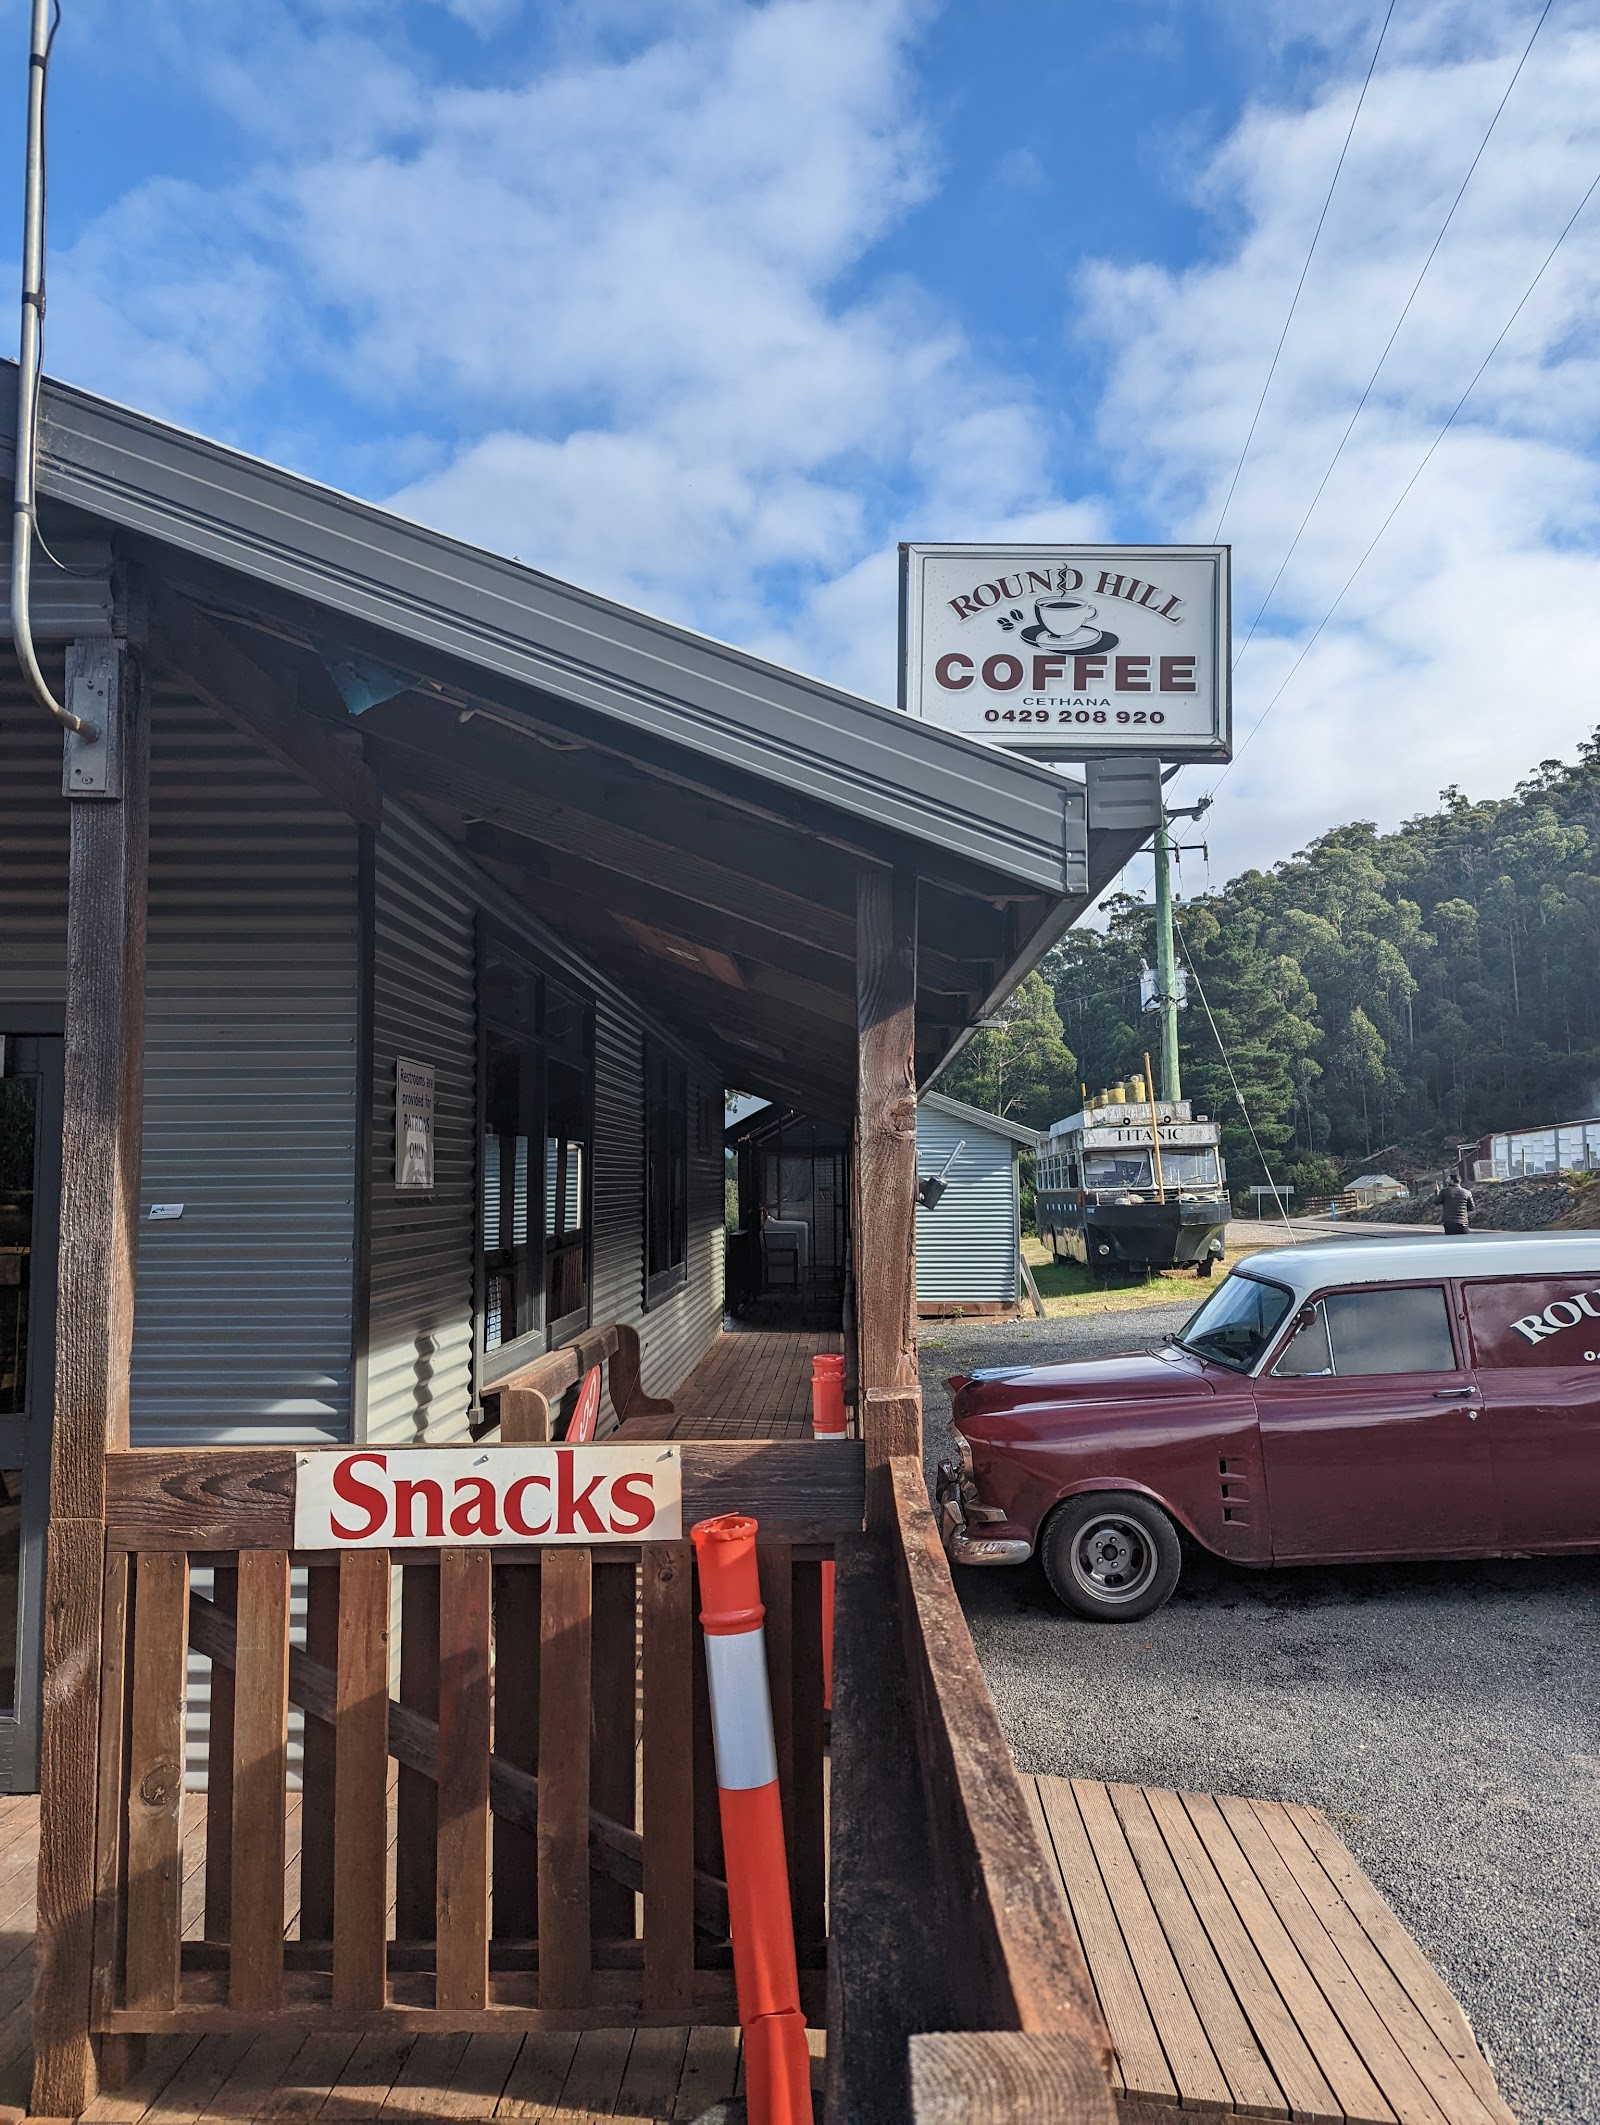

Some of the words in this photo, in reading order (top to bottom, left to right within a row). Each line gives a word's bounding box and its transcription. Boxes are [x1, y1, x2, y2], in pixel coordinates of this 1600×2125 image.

[947, 568, 1084, 621] ROUND
[1094, 571, 1183, 623] HILL
[935, 653, 1196, 692] COFFEE
[1023, 697, 1111, 707] CETHANA
[985, 709, 1049, 723] 0429
[1059, 710, 1107, 724] 208
[1116, 711, 1165, 725] 920
[400, 1068, 426, 1088] Restrooms
[426, 1077, 434, 1089] are
[402, 1092, 424, 1108] provided
[404, 1113, 430, 1133] PATRONS
[1116, 1128, 1183, 1141] TITANIC
[409, 1142, 425, 1160] ONLY
[1584, 1350, 1600, 1361] 0
[330, 1450, 656, 1540] Snacks
